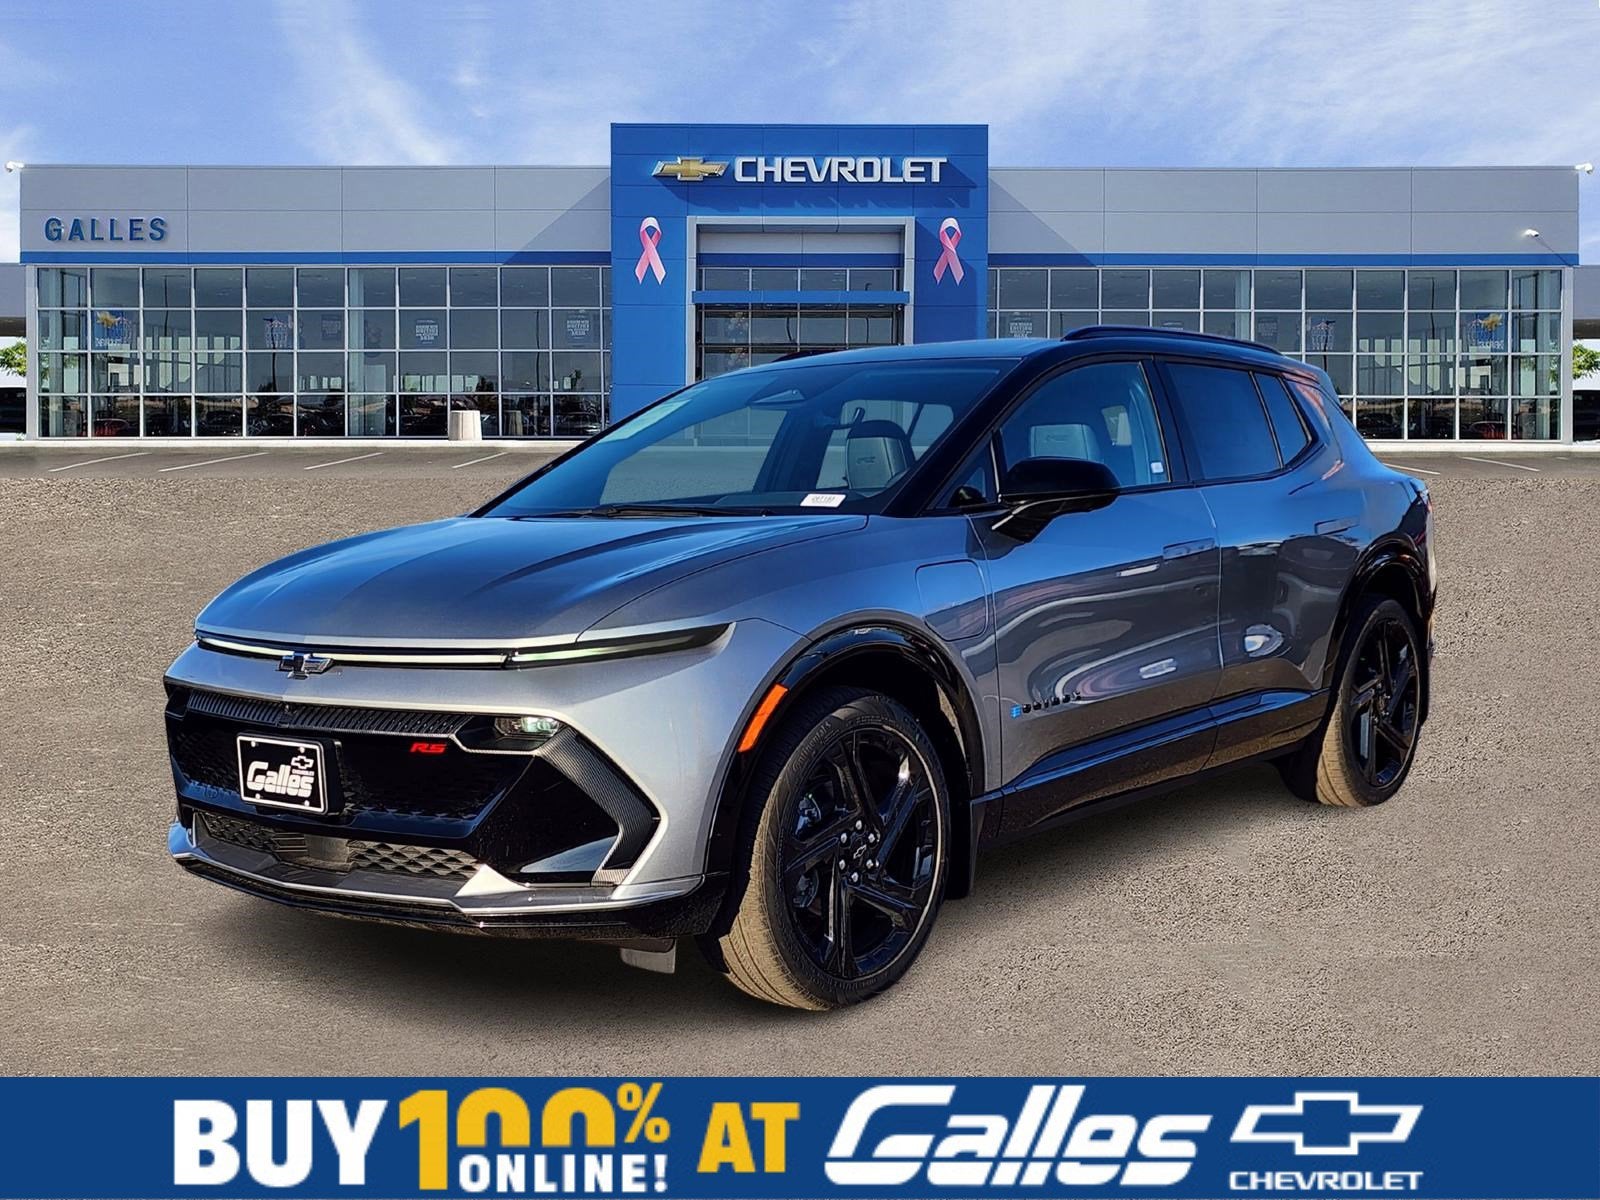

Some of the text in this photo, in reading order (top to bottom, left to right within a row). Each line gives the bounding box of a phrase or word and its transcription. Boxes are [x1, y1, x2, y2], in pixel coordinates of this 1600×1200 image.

[734, 156, 948, 184] CHEVROLET
[44, 216, 167, 242] GALLES
[410, 742, 448, 753] RS
[246, 760, 315, 798] Galles
